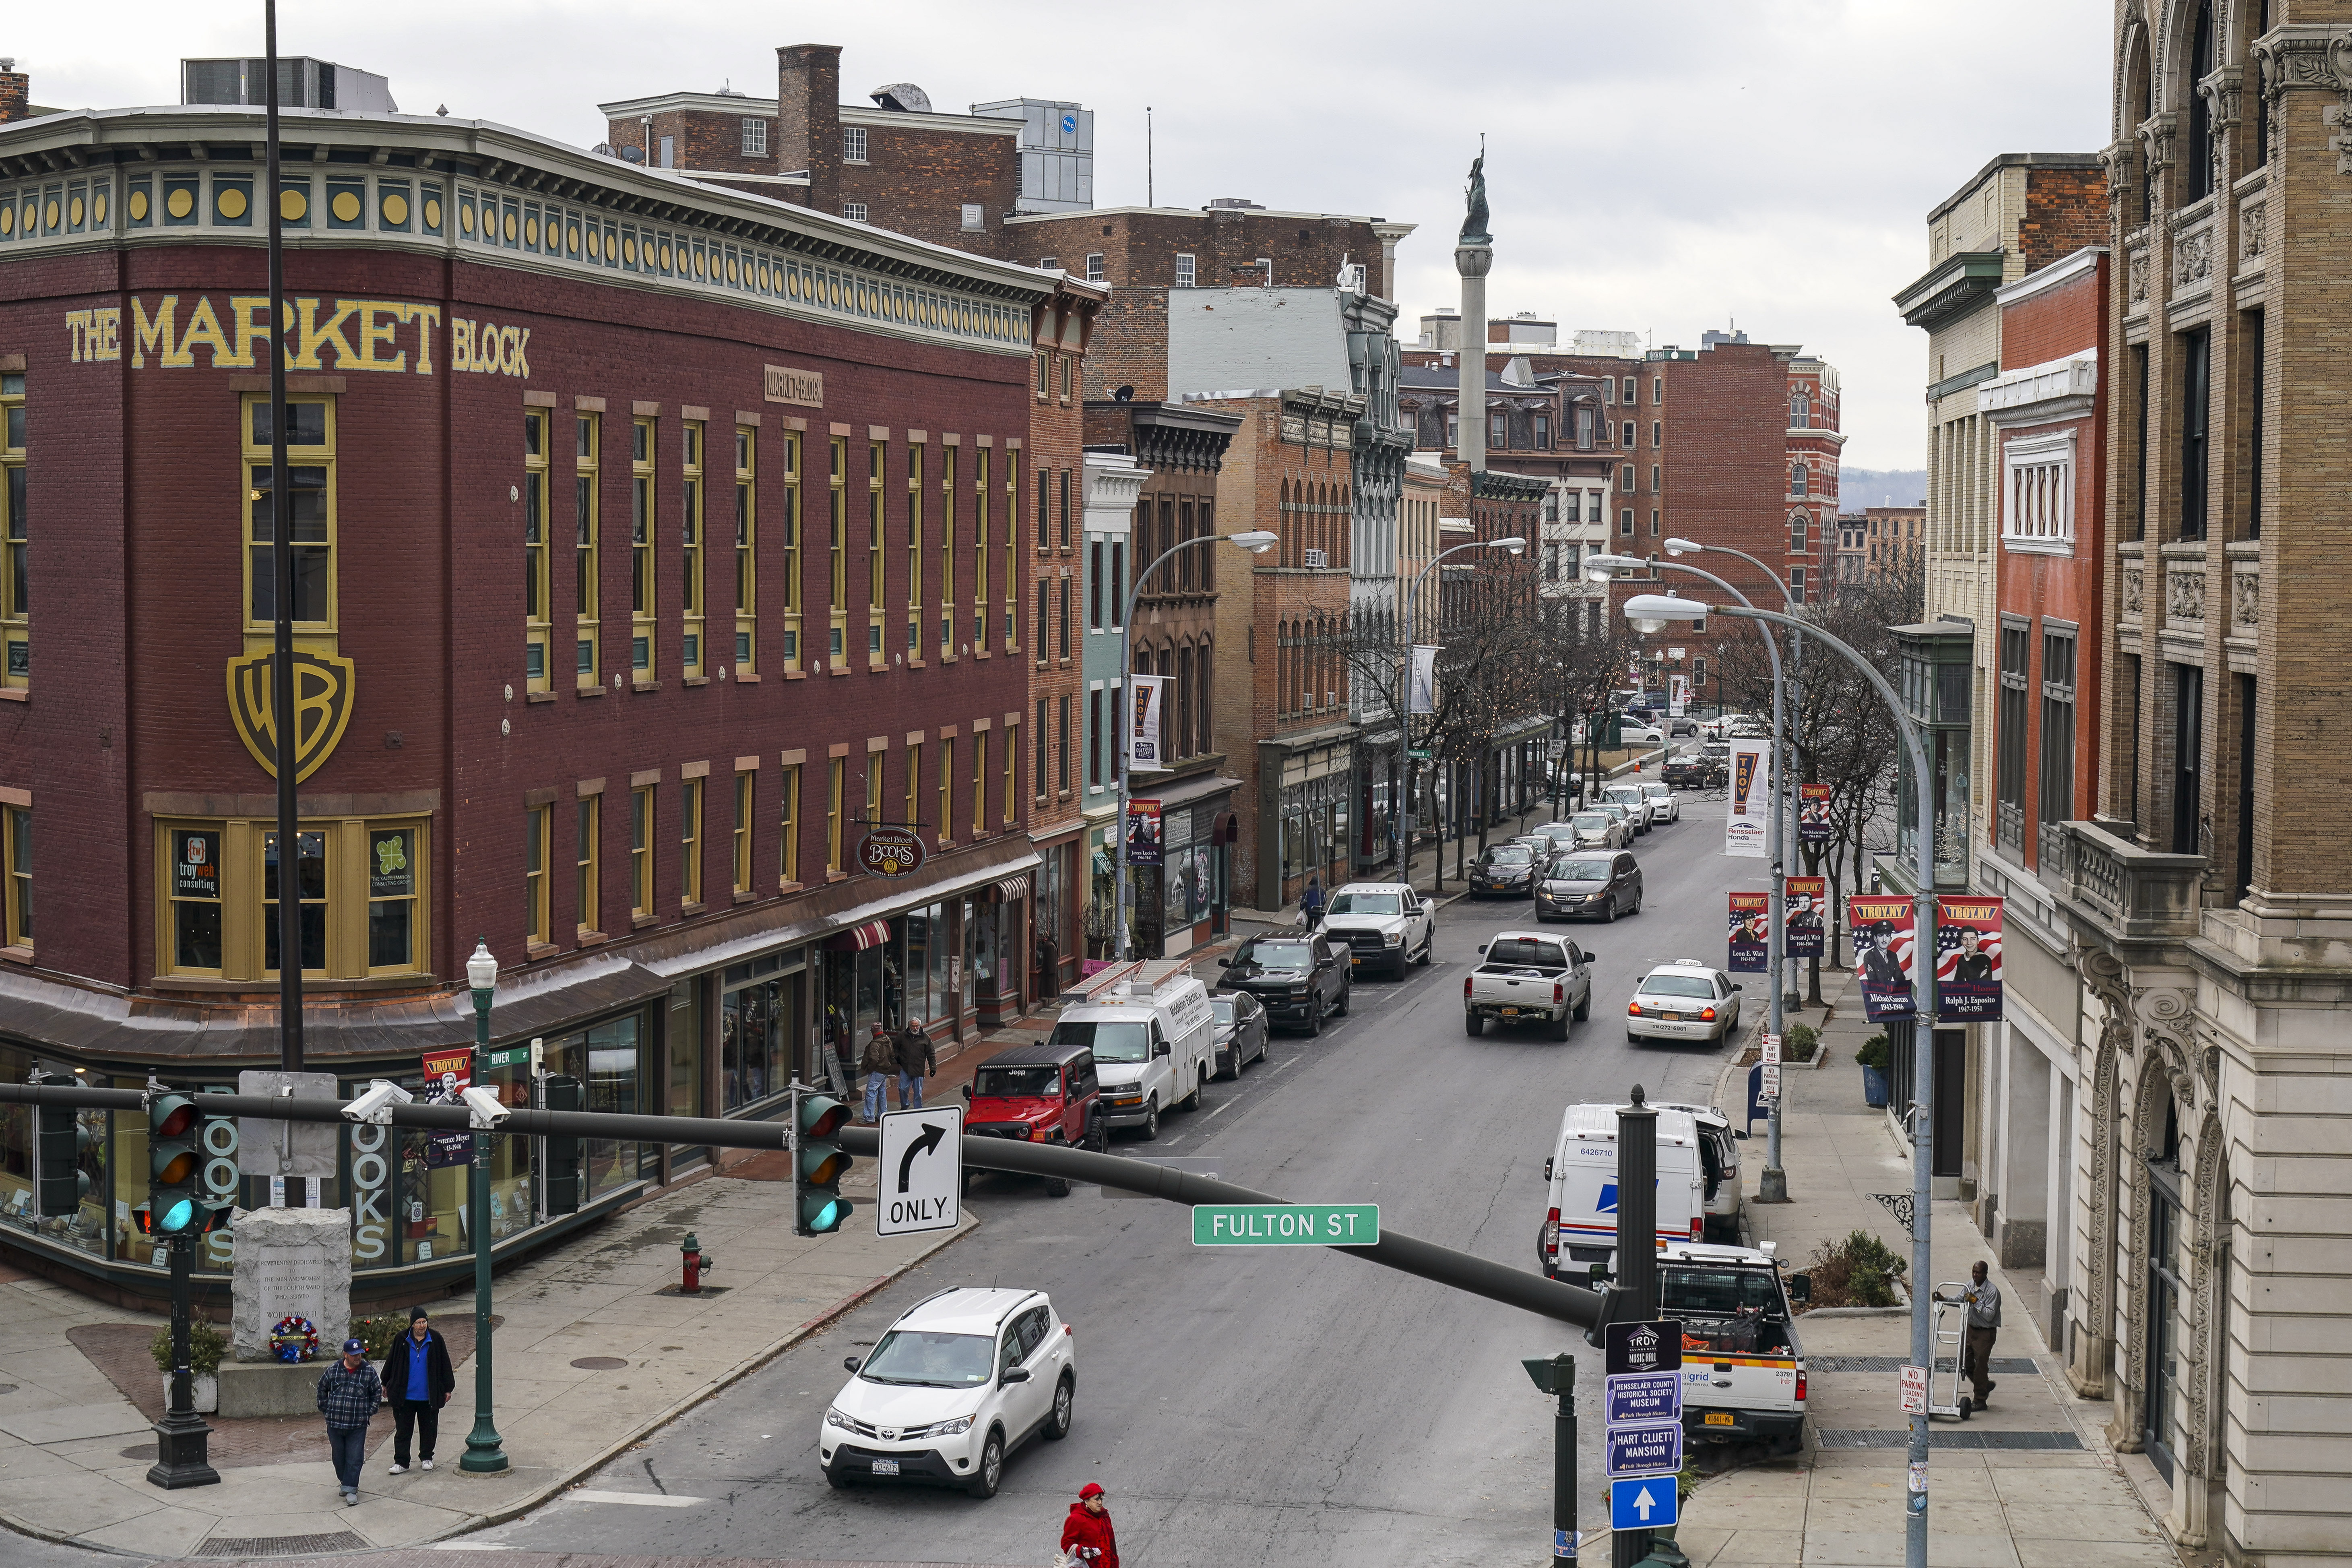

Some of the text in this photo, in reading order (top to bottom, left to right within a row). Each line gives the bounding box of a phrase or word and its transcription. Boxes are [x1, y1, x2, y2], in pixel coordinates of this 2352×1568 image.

[1064, 120, 1074, 129] BAC
[66, 295, 530, 380] THE MARKET BLOCK
[244, 663, 338, 764] WB
[1738, 758, 1748, 796] TROY
[894, 836, 913, 844] Block
[869, 844, 913, 864] BOOKS
[180, 879, 214, 891] consulting
[1735, 898, 1762, 906] TROY.NY
[1861, 906, 1903, 918] TROY.NY
[1949, 907, 1991, 919] TROY.NY
[1870, 993, 1891, 1002] Michael
[1945, 996, 1995, 1006] Ralph J. Esposito
[491, 1052, 510, 1065] RIVER
[432, 1058, 463, 1072] TROY.NY
[455, 1133, 470, 1143] Meyer
[1581, 1148, 1613, 1157] 6426710
[891, 1196, 948, 1224] ONLY
[1213, 1213, 1359, 1237] FULTON ST
[1629, 1336, 1657, 1347] TROY
[1629, 1352, 1657, 1363] MUSIC HALL
[1682, 1371, 1709, 1382] algrid
[1908, 1370, 1918, 1380] NO
[1617, 1380, 1674, 1390] RENSSELAER COUNTY
[1902, 1379, 1924, 1391] PARKING
[1617, 1390, 1648, 1399] HISTORICAL
[1902, 1389, 1923, 1398] LOADING
[1630, 1398, 1660, 1408] MUSEUM
[1617, 1431, 1673, 1446] HART CLUETT
[1626, 1445, 1665, 1458] MANSION
